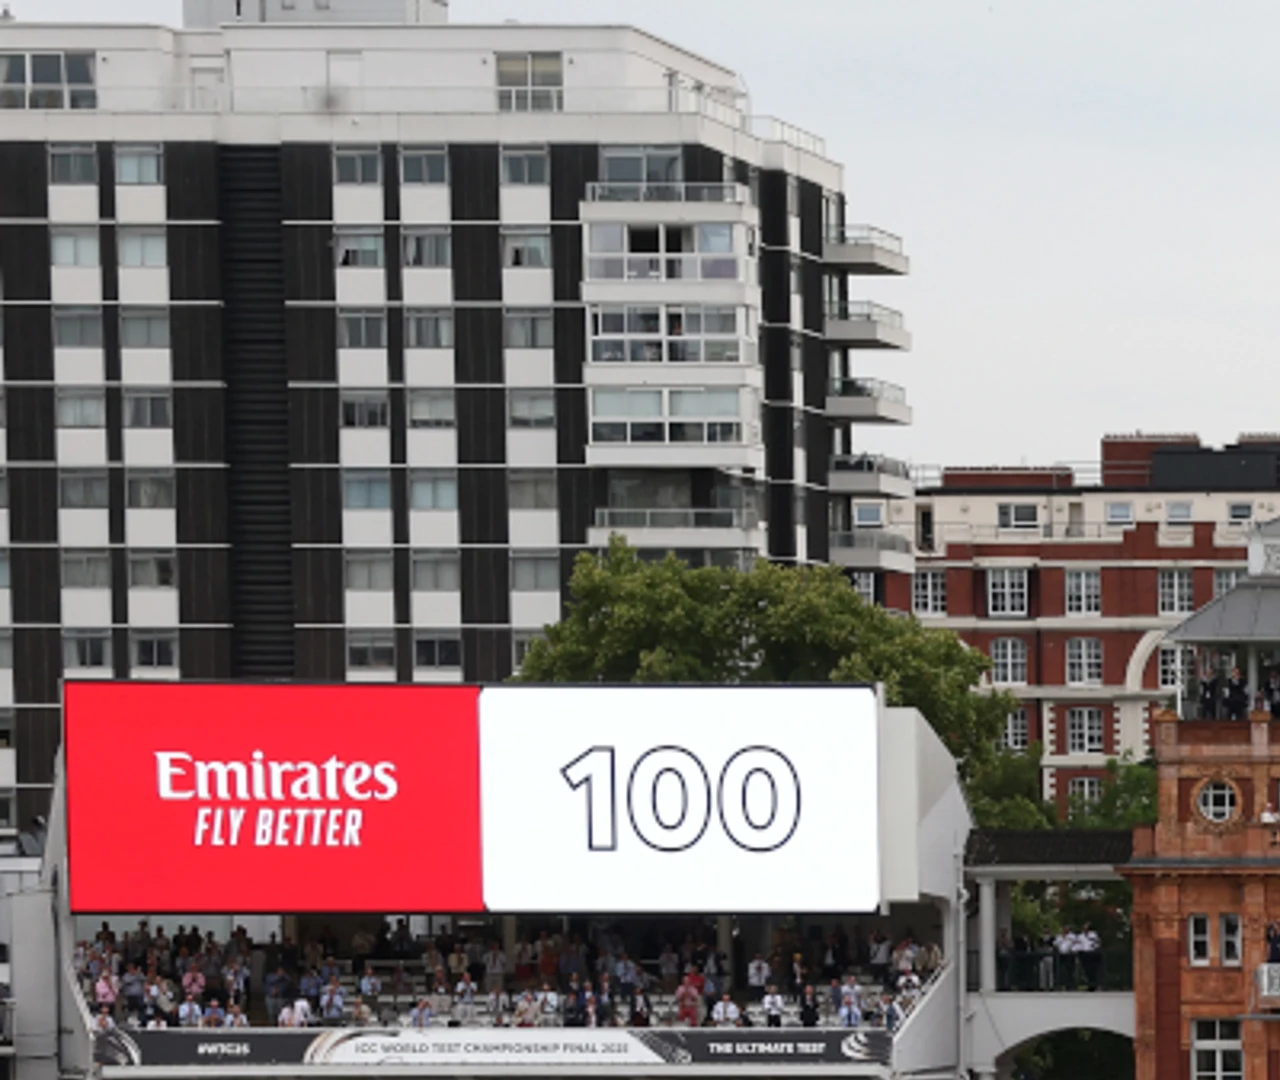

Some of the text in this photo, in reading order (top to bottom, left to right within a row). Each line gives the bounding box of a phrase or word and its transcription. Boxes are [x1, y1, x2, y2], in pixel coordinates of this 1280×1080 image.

[153, 748, 399, 801] Emirates
[559, 744, 802, 853] 100
[194, 807, 363, 846] FLY BETTER
[708, 1043, 827, 1054] THE ULTIMATE TEST
